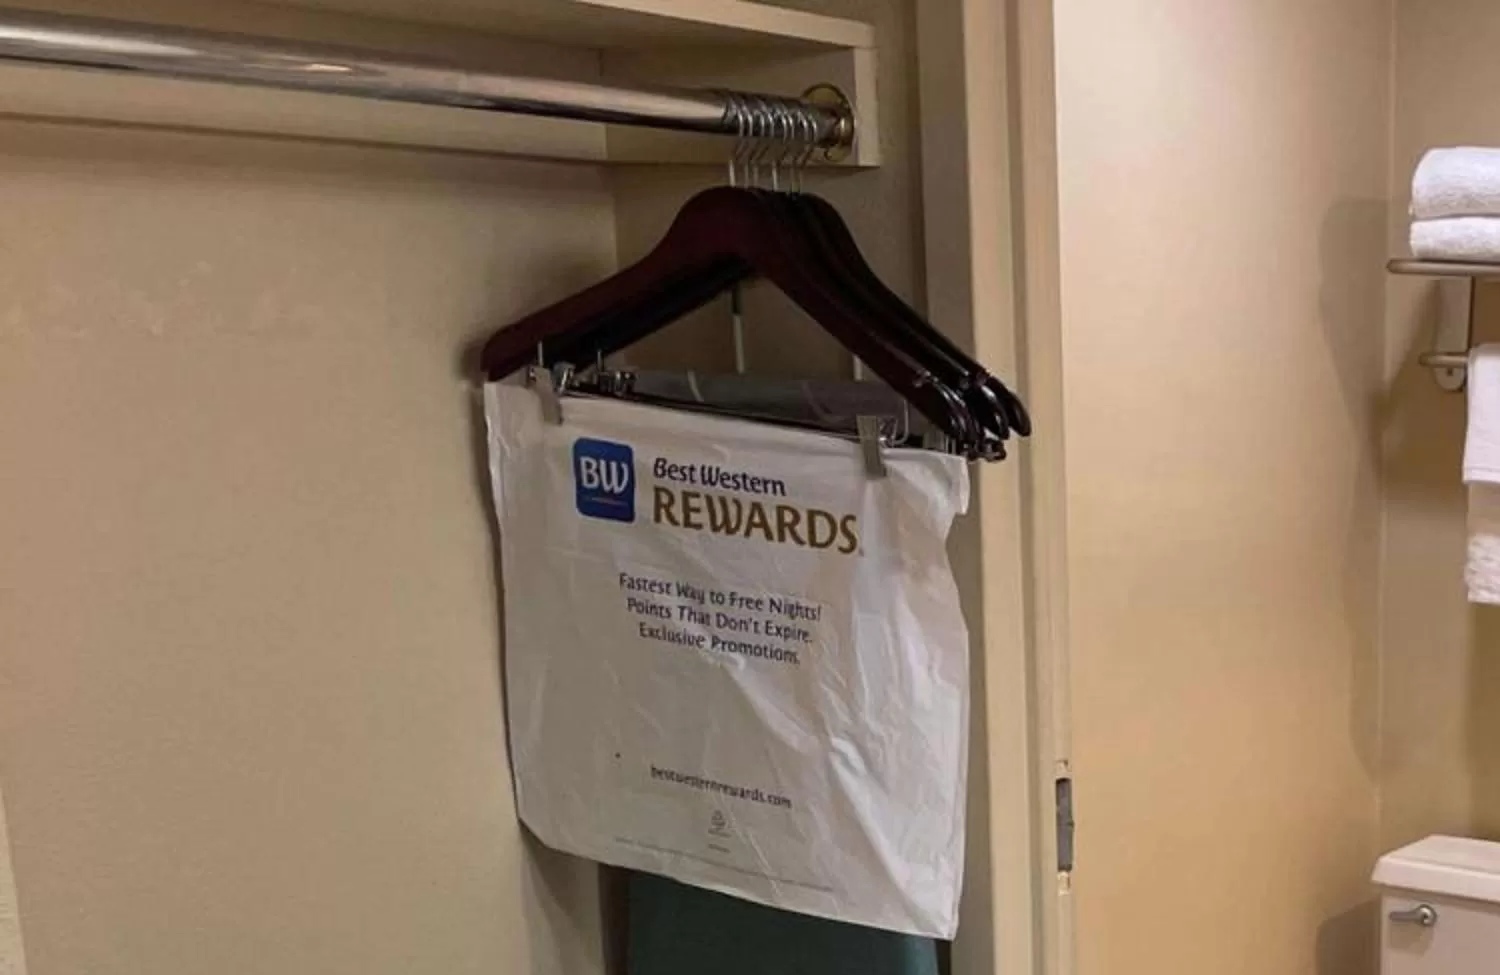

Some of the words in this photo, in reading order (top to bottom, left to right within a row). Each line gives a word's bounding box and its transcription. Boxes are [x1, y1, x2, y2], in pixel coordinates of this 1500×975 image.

[580, 456, 629, 494] BW
[653, 457, 697, 484] Best
[700, 463, 787, 497] Western
[653, 486, 859, 554] REWARDS
[619, 572, 672, 596] Fastest
[676, 581, 705, 605] Way
[710, 590, 725, 606] to
[729, 591, 764, 613] Free
[769, 598, 823, 622] Nights!
[627, 597, 673, 619] Points
[678, 605, 711, 626] That
[715, 612, 761, 635] Don't
[765, 621, 814, 644] Expire.
[639, 621, 705, 649] Exclusive
